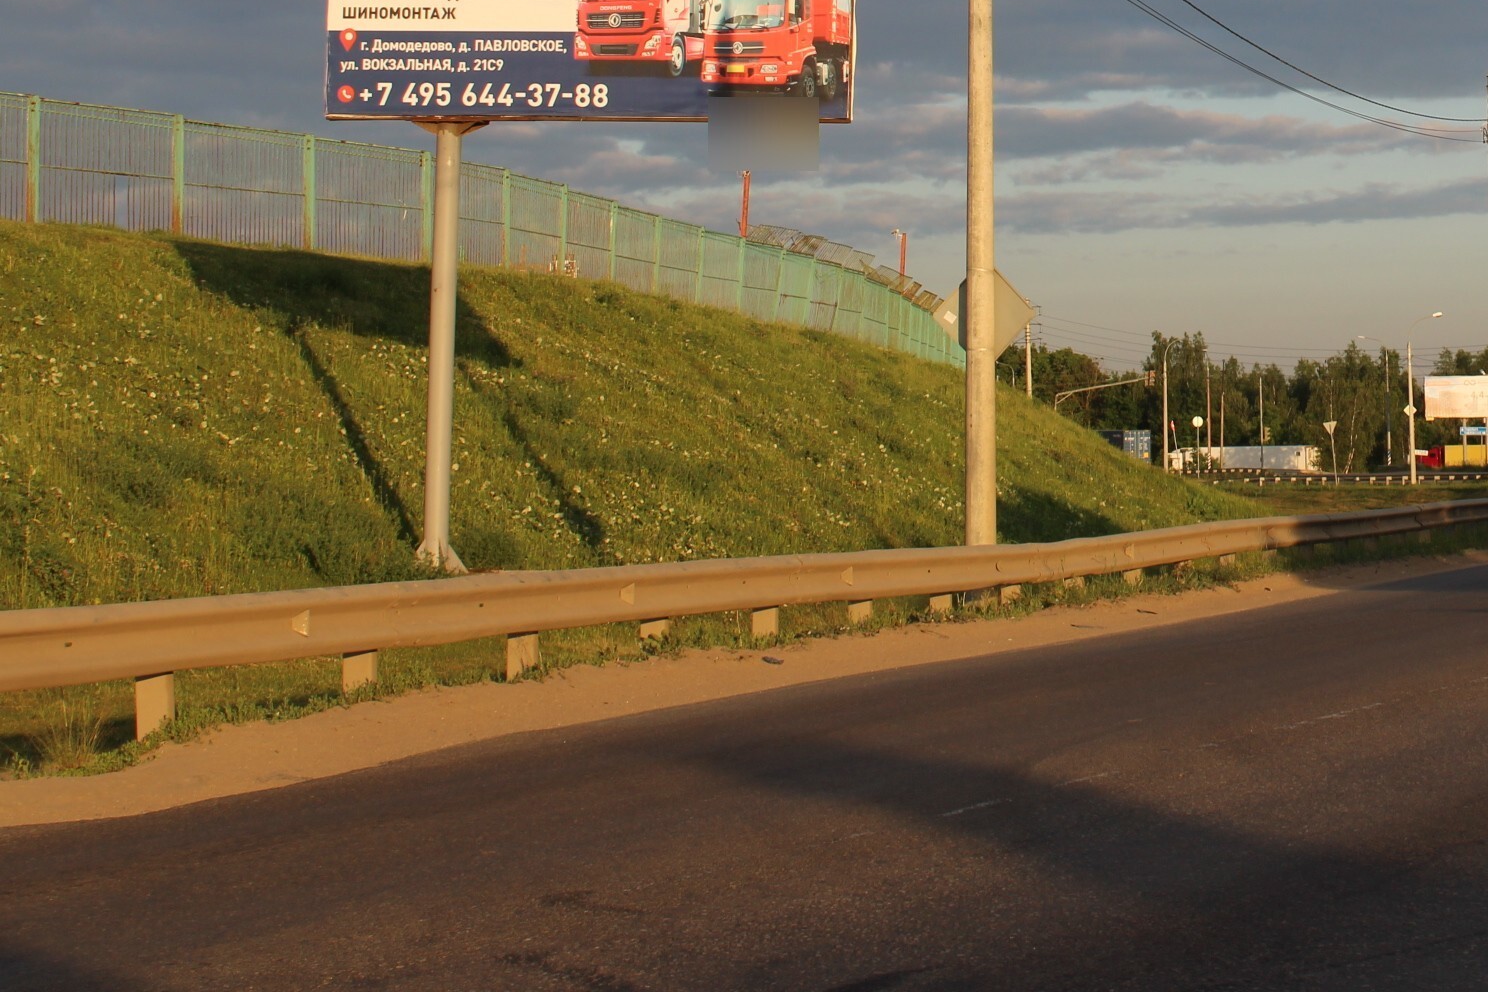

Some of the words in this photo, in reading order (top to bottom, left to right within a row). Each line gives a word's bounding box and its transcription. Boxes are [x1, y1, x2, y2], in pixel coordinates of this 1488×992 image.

[342, 6, 456, 20] ШИНОМОНТАЖ
[360, 42, 369, 52] г.
[372, 39, 456, 54] Домодедово,
[458, 42, 471, 54] д.
[474, 39, 567, 54] ПАВЛОВСКОЕ,
[340, 61, 358, 73] ул.
[362, 58, 454, 73] ВОКЗАЛЬНАЯ,
[457, 61, 470, 73] д.
[402, 82, 451, 106] 495
[461, 82, 609, 108] 644-37-88
